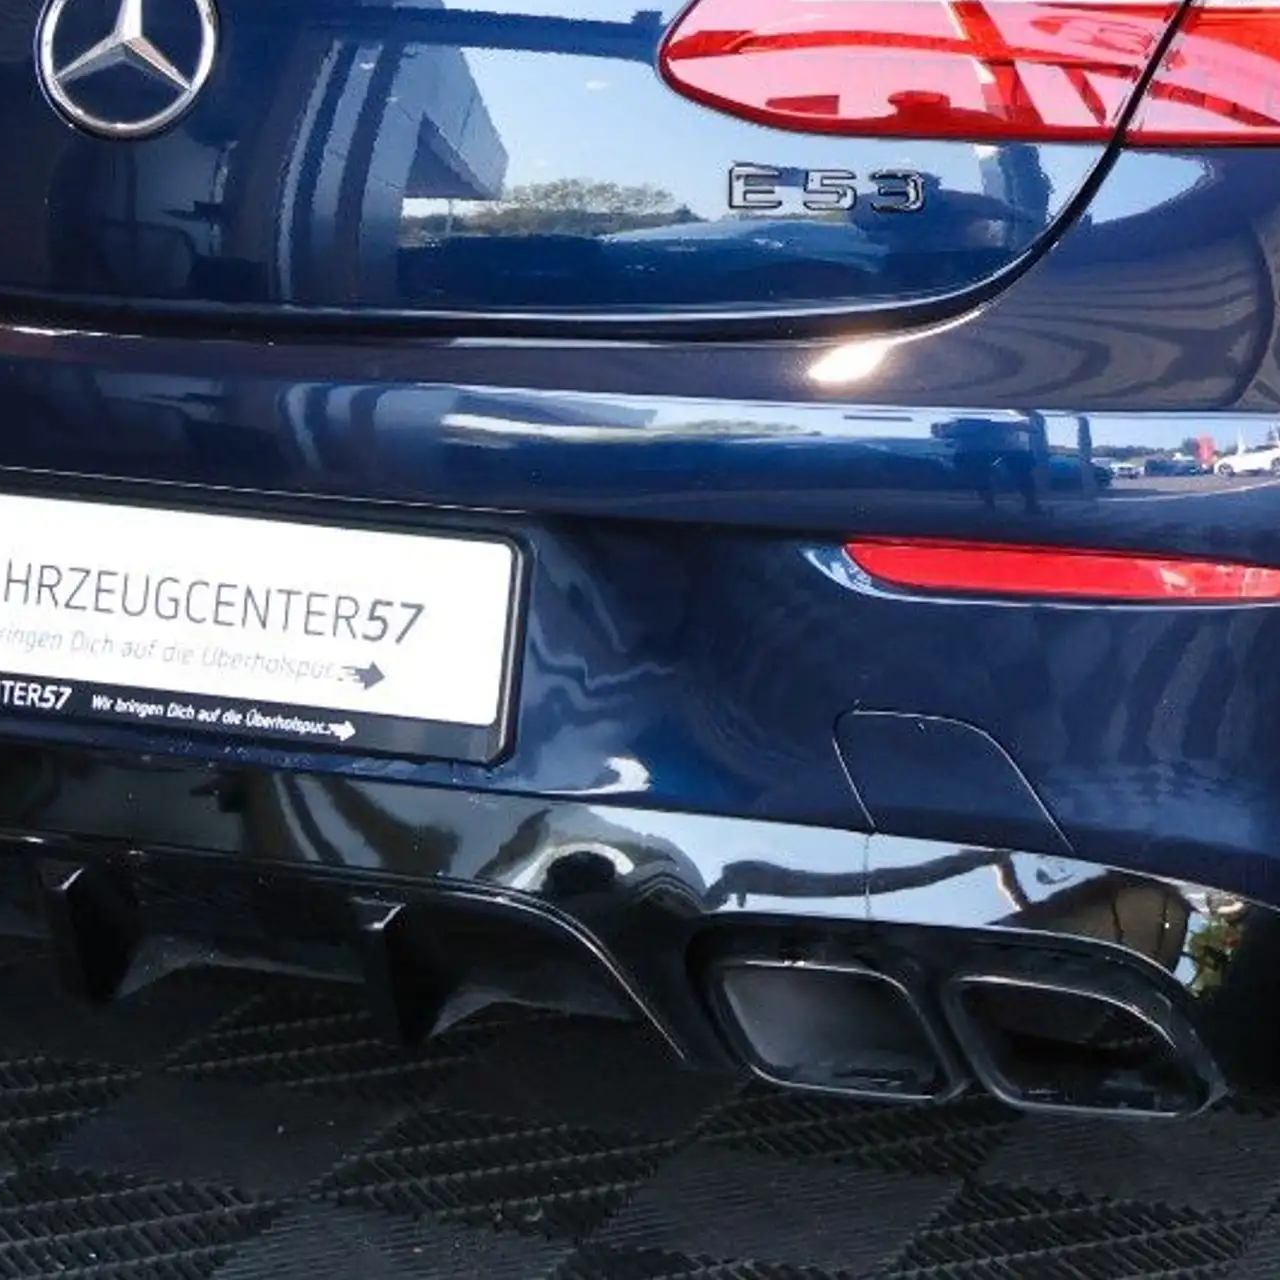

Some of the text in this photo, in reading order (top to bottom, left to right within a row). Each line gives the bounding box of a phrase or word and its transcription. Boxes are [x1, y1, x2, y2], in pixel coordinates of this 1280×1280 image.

[69, 628, 115, 656] Dich
[120, 637, 160, 662] auf
[161, 642, 196, 667] die
[92, 694, 113, 711] Wir
[115, 697, 165, 718] bringen
[167, 702, 195, 720] Dich
[197, 708, 221, 723] auf
[222, 708, 243, 726] die
